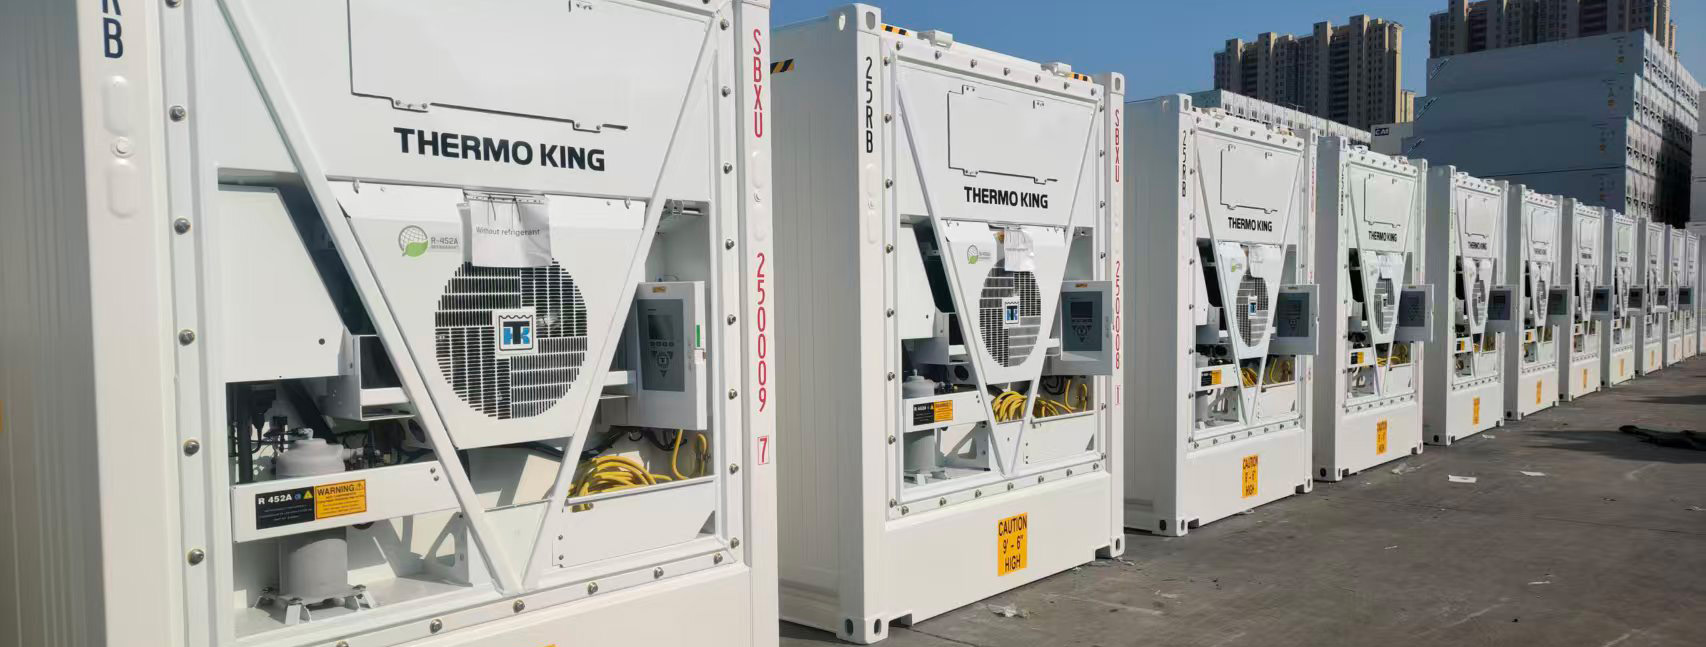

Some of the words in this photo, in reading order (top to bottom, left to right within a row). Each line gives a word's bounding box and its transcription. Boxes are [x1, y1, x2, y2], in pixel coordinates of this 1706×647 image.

[753, 28, 763, 138] SBXU
[865, 56, 874, 153] 25RB
[393, 126, 534, 166] THERMO
[540, 143, 605, 172] KING
[963, 185, 1019, 207] THERMO
[1020, 191, 1049, 209] KING
[475, 225, 500, 235] Without
[501, 227, 540, 237] refrigerant
[1227, 216, 1257, 231] THERMO
[1256, 220, 1273, 232] KING
[430, 236, 459, 245] R-452A
[756, 252, 767, 413] 250009
[758, 436, 769, 464] 7
[258, 497, 265, 505] R
[268, 493, 293, 504] 452A
[317, 483, 355, 496] WARNING
[998, 515, 1027, 537] CAUTION
[1005, 553, 1021, 573] HIGH
